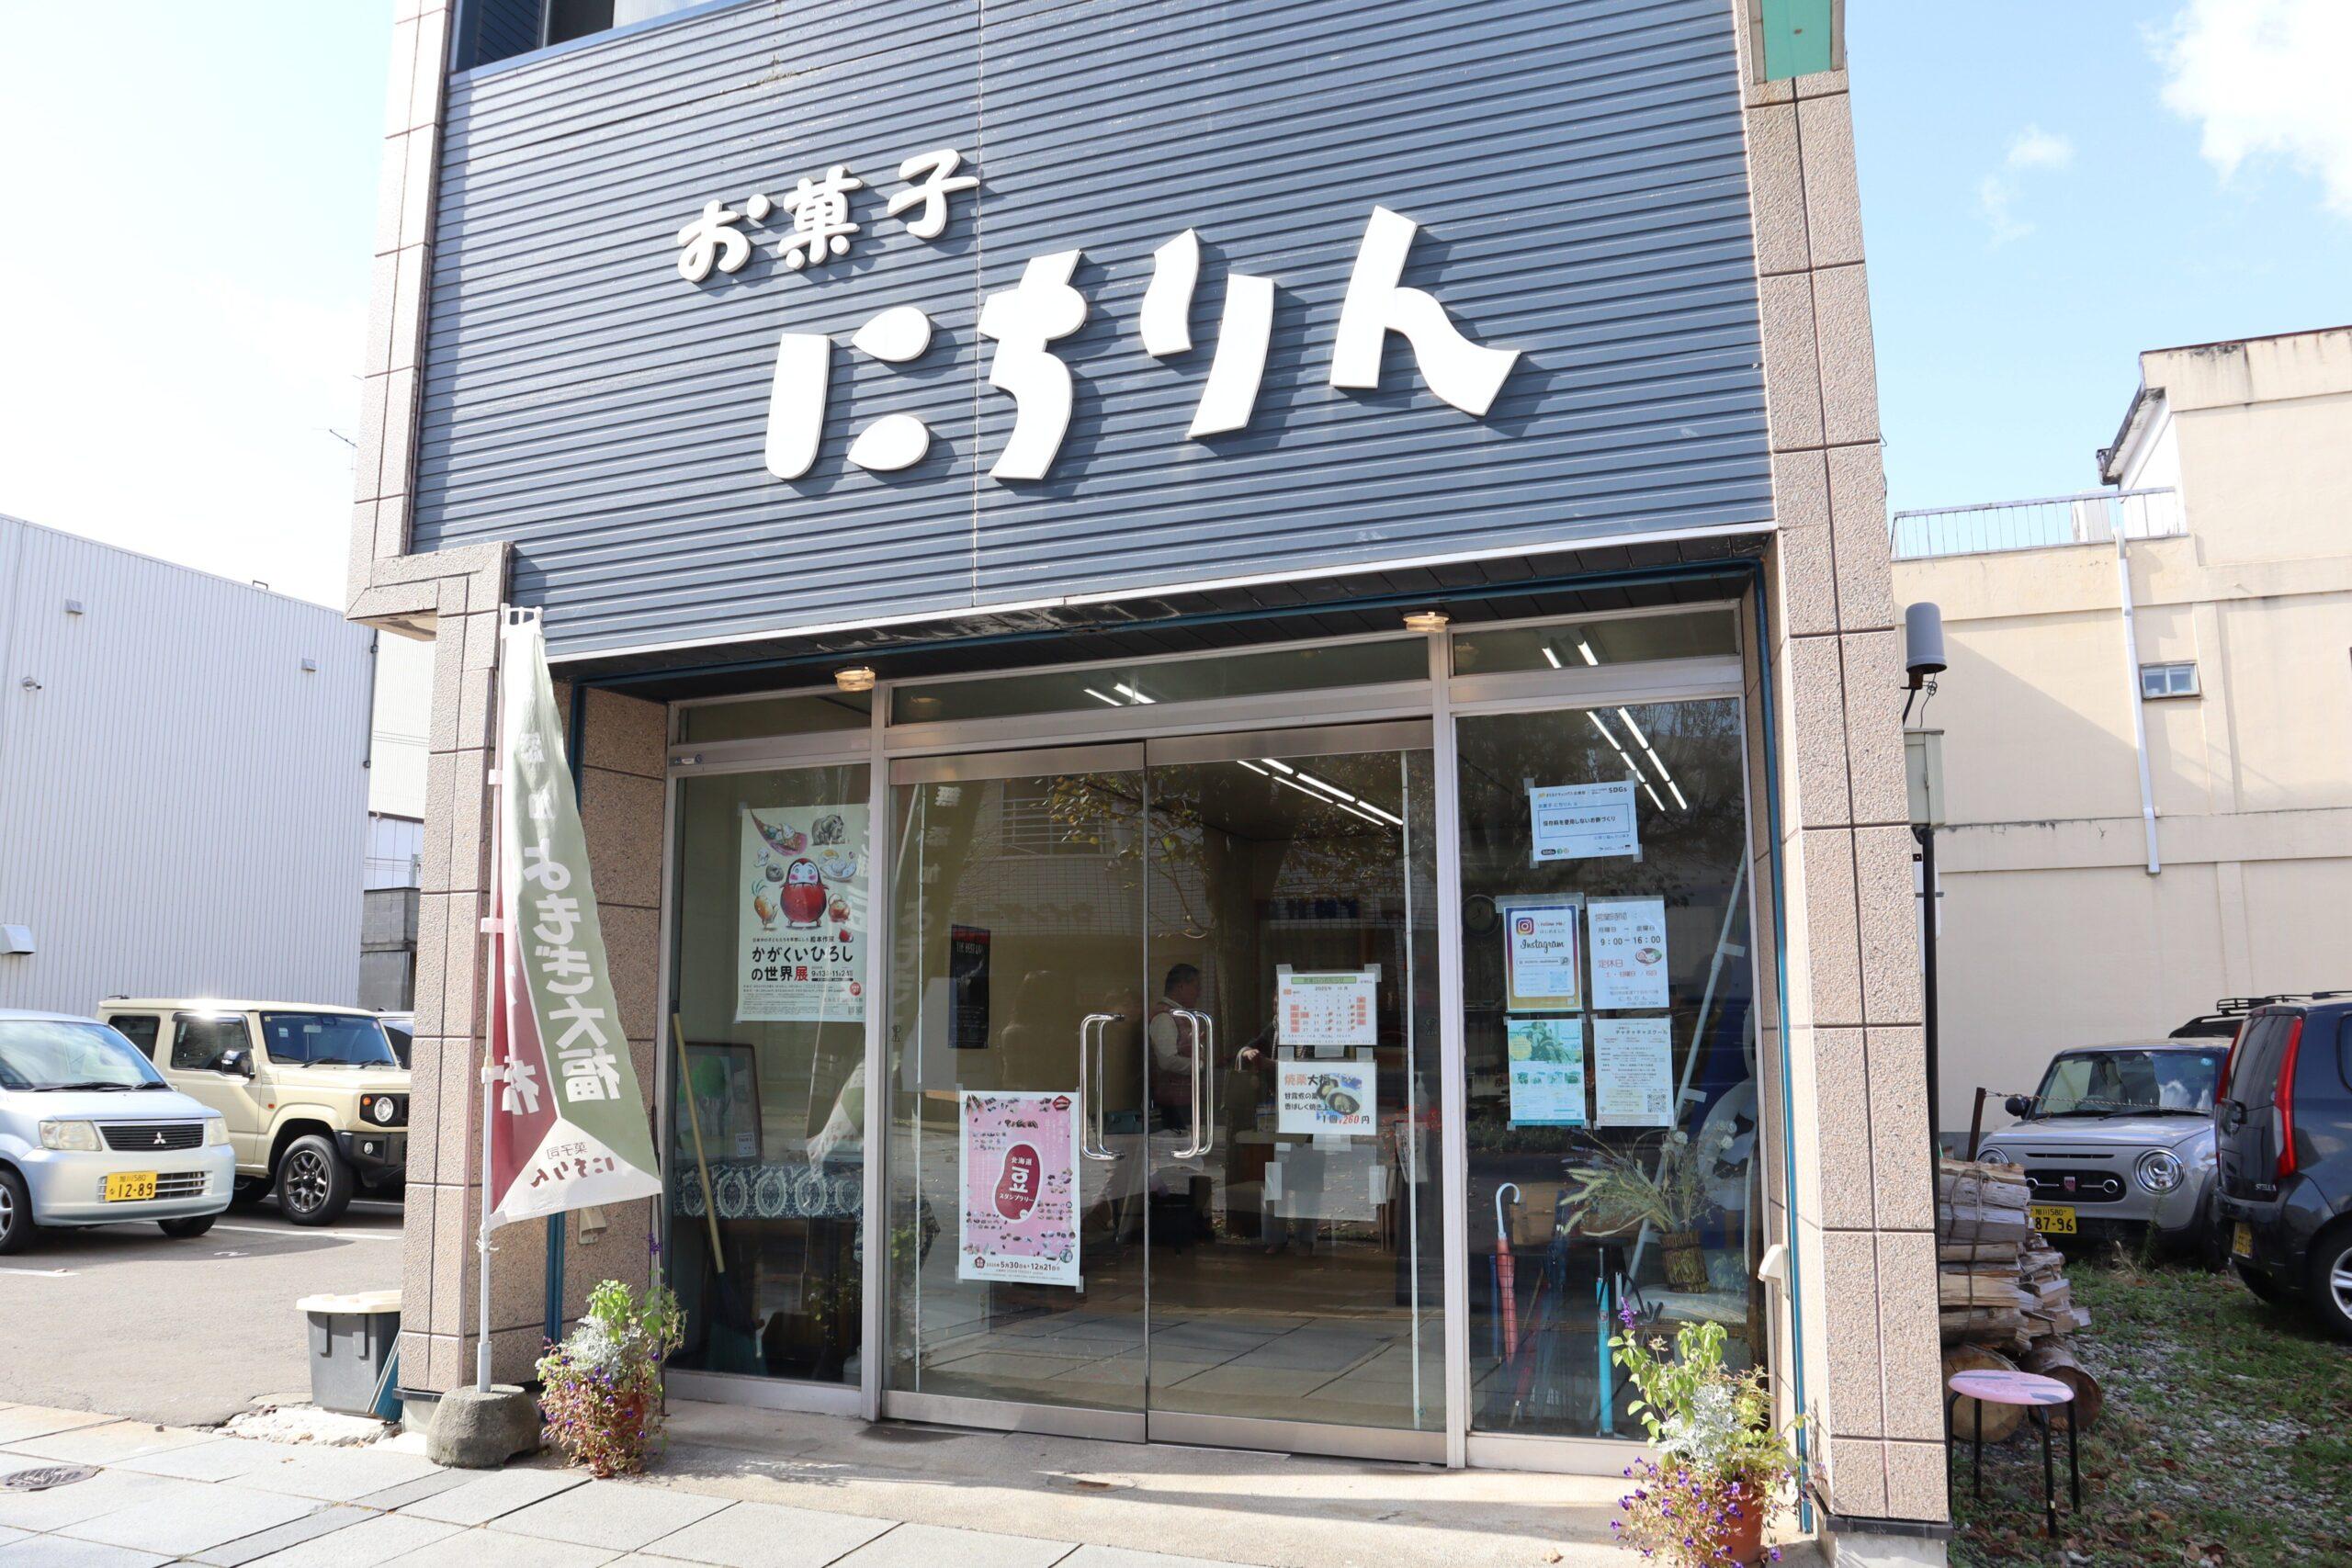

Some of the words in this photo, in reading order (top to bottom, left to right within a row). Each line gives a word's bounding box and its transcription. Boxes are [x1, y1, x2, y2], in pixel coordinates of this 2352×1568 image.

[677, 148, 980, 282] お菓子
[763, 205, 1521, 480] にちりん
[752, 945, 854, 963] かがくいひろし
[1520, 939, 1565, 953] Instagram
[751, 965, 808, 981] の世界展
[1011, 1156, 1033, 1166] 北海道
